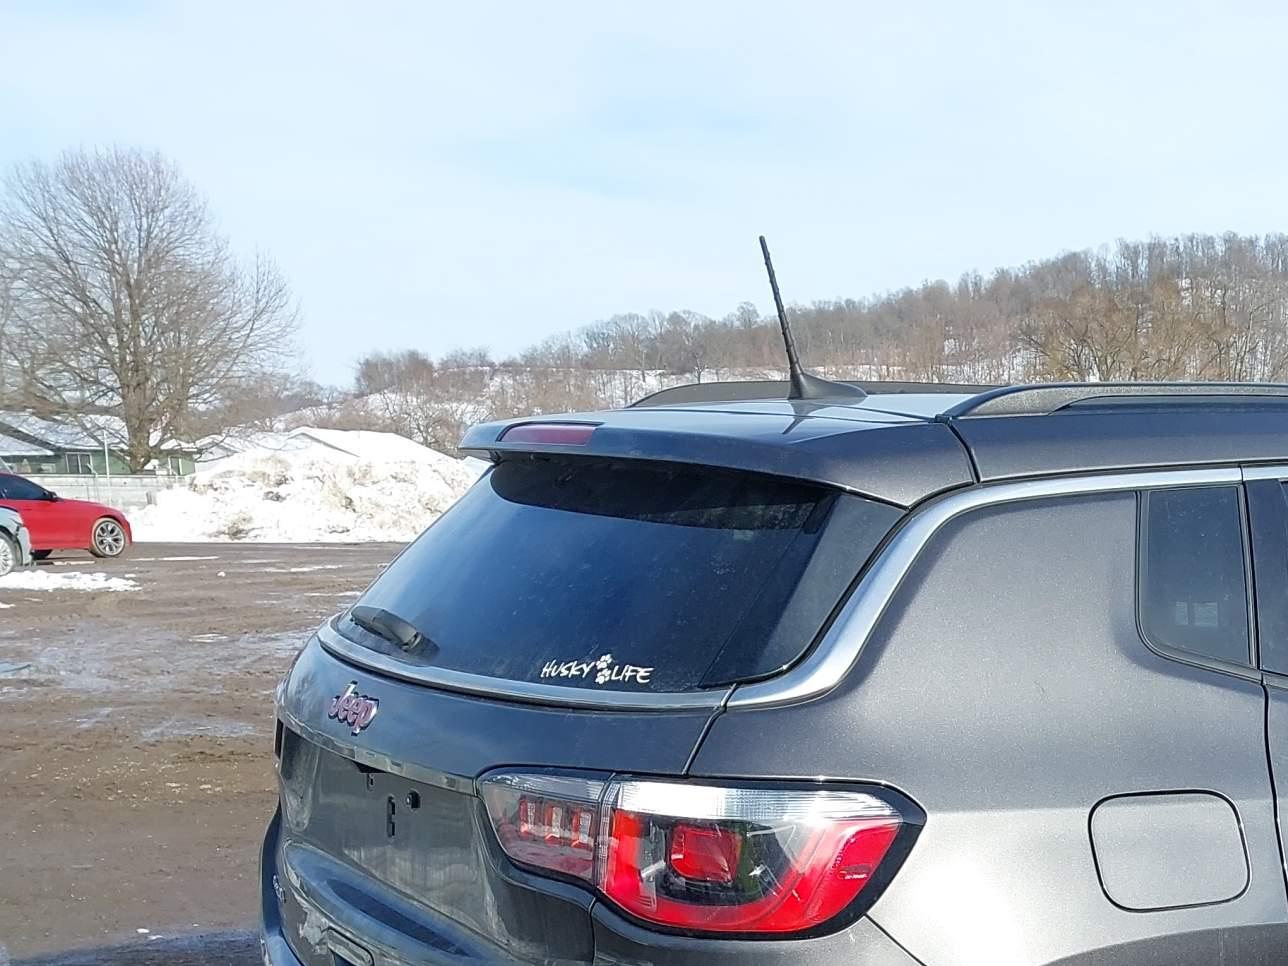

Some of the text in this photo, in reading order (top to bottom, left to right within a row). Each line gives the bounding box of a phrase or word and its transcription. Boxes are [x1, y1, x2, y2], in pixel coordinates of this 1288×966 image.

[540, 659, 655, 683] HUSKY LIFE
[328, 682, 379, 735] Jeep
